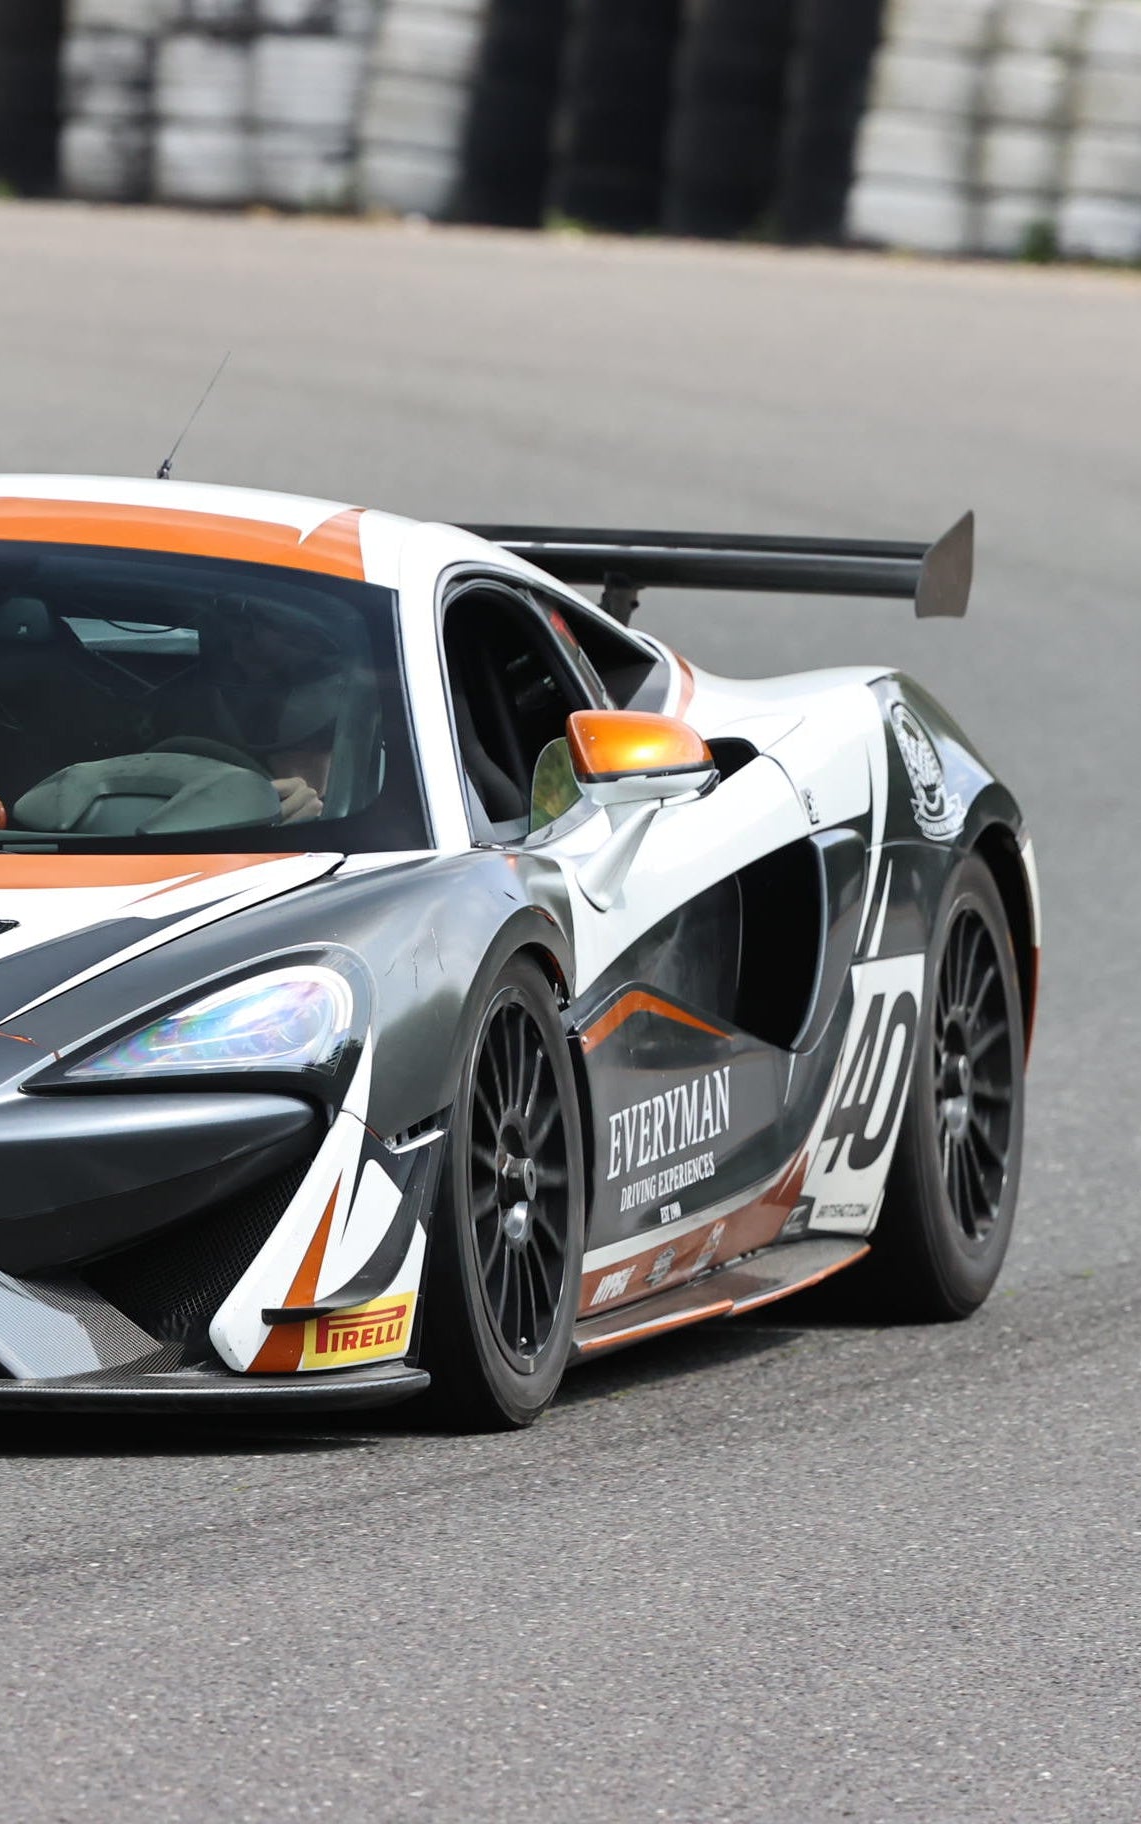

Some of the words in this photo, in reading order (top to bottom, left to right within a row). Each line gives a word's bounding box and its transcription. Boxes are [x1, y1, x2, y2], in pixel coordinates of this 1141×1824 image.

[607, 1065, 730, 1181] EVERYMAN
[821, 990, 918, 1175] 40
[620, 1174, 657, 1213] DRIVING
[657, 1150, 716, 1197] EXPERIENCES
[314, 1304, 407, 1354] PIRELLI
